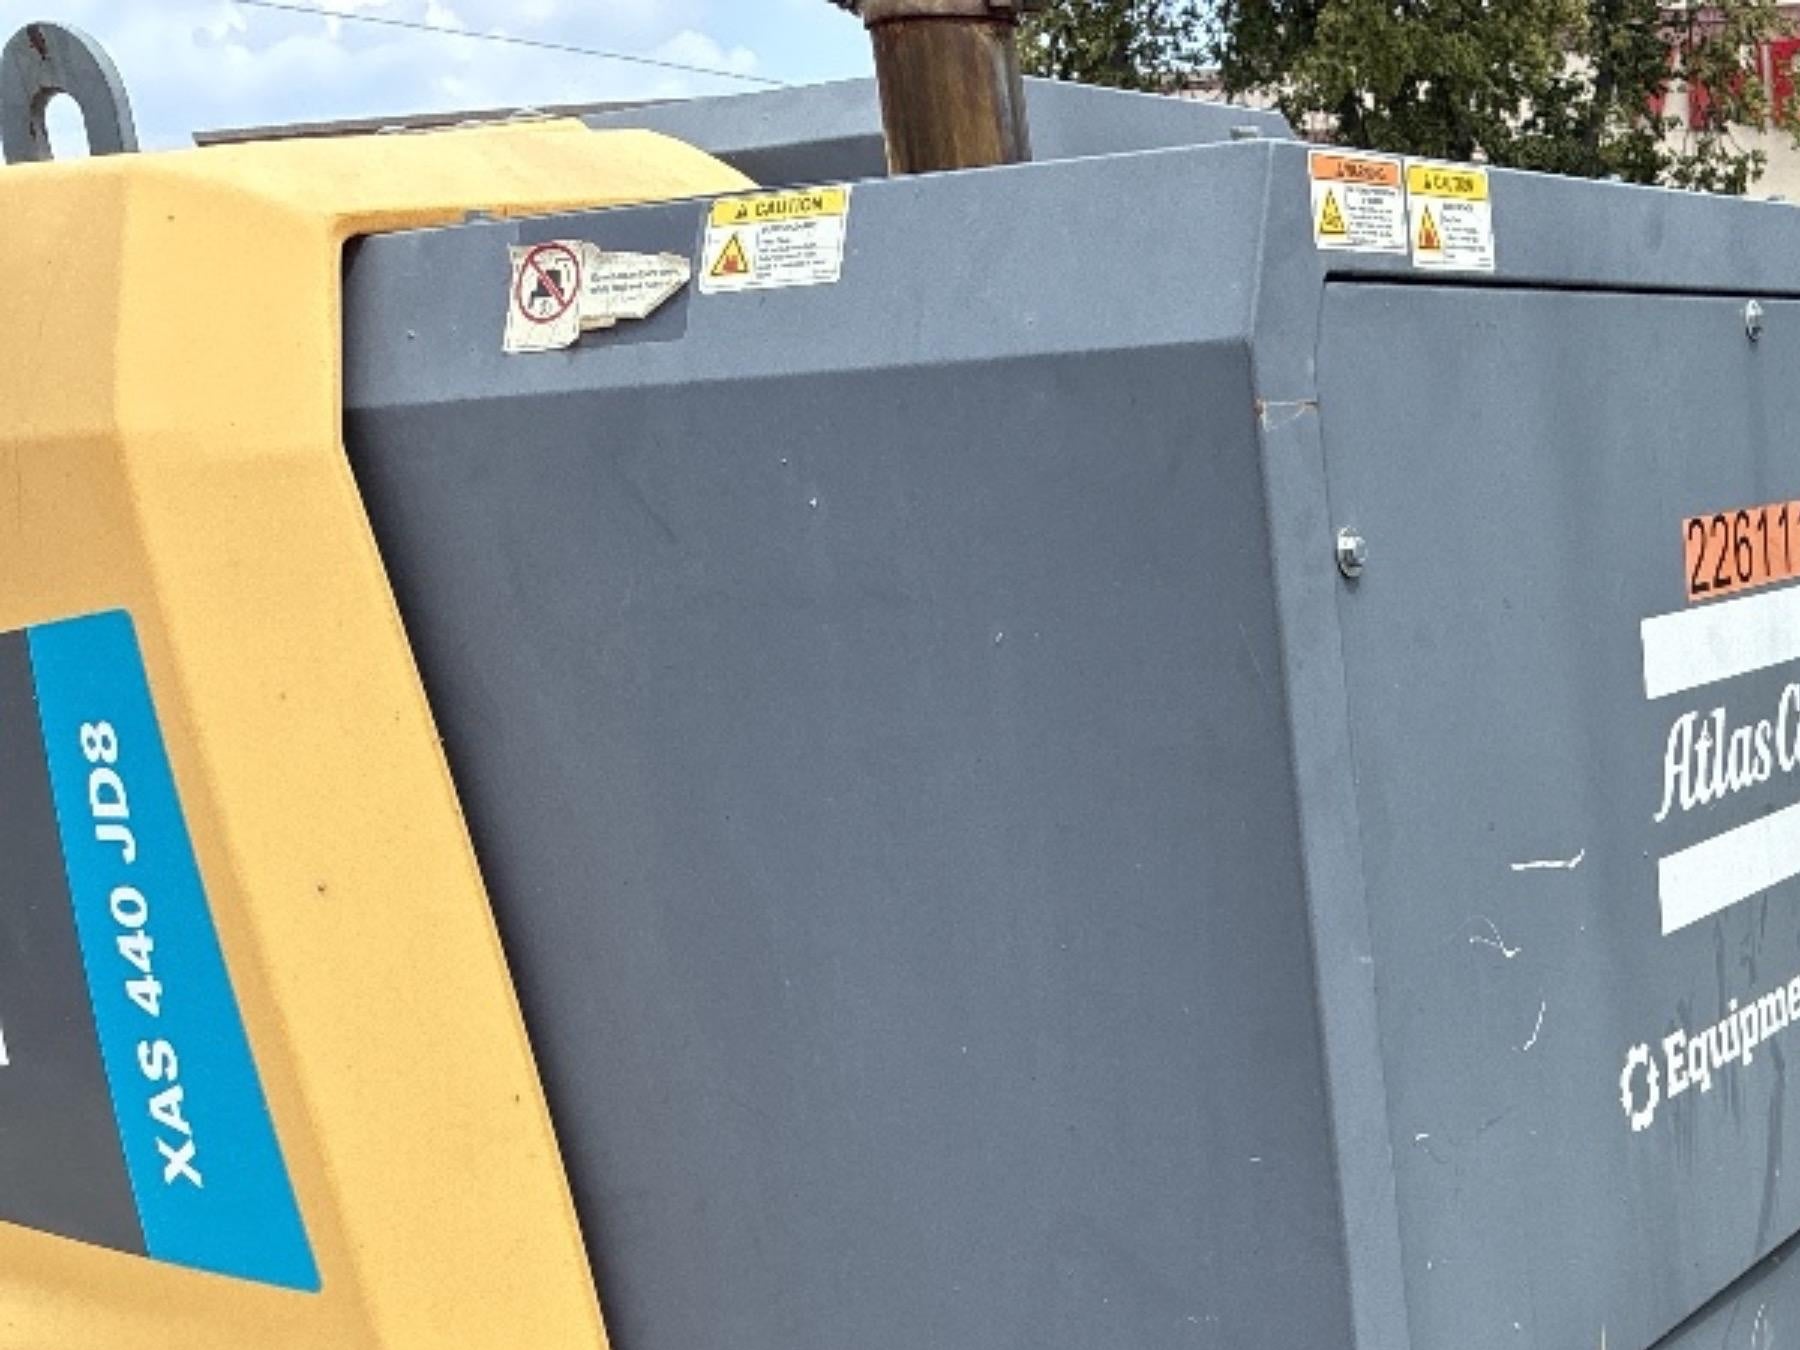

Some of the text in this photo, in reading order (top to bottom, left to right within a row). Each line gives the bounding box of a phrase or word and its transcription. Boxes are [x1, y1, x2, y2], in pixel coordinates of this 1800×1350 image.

[79, 719, 204, 1189] XAS 440 JD8
